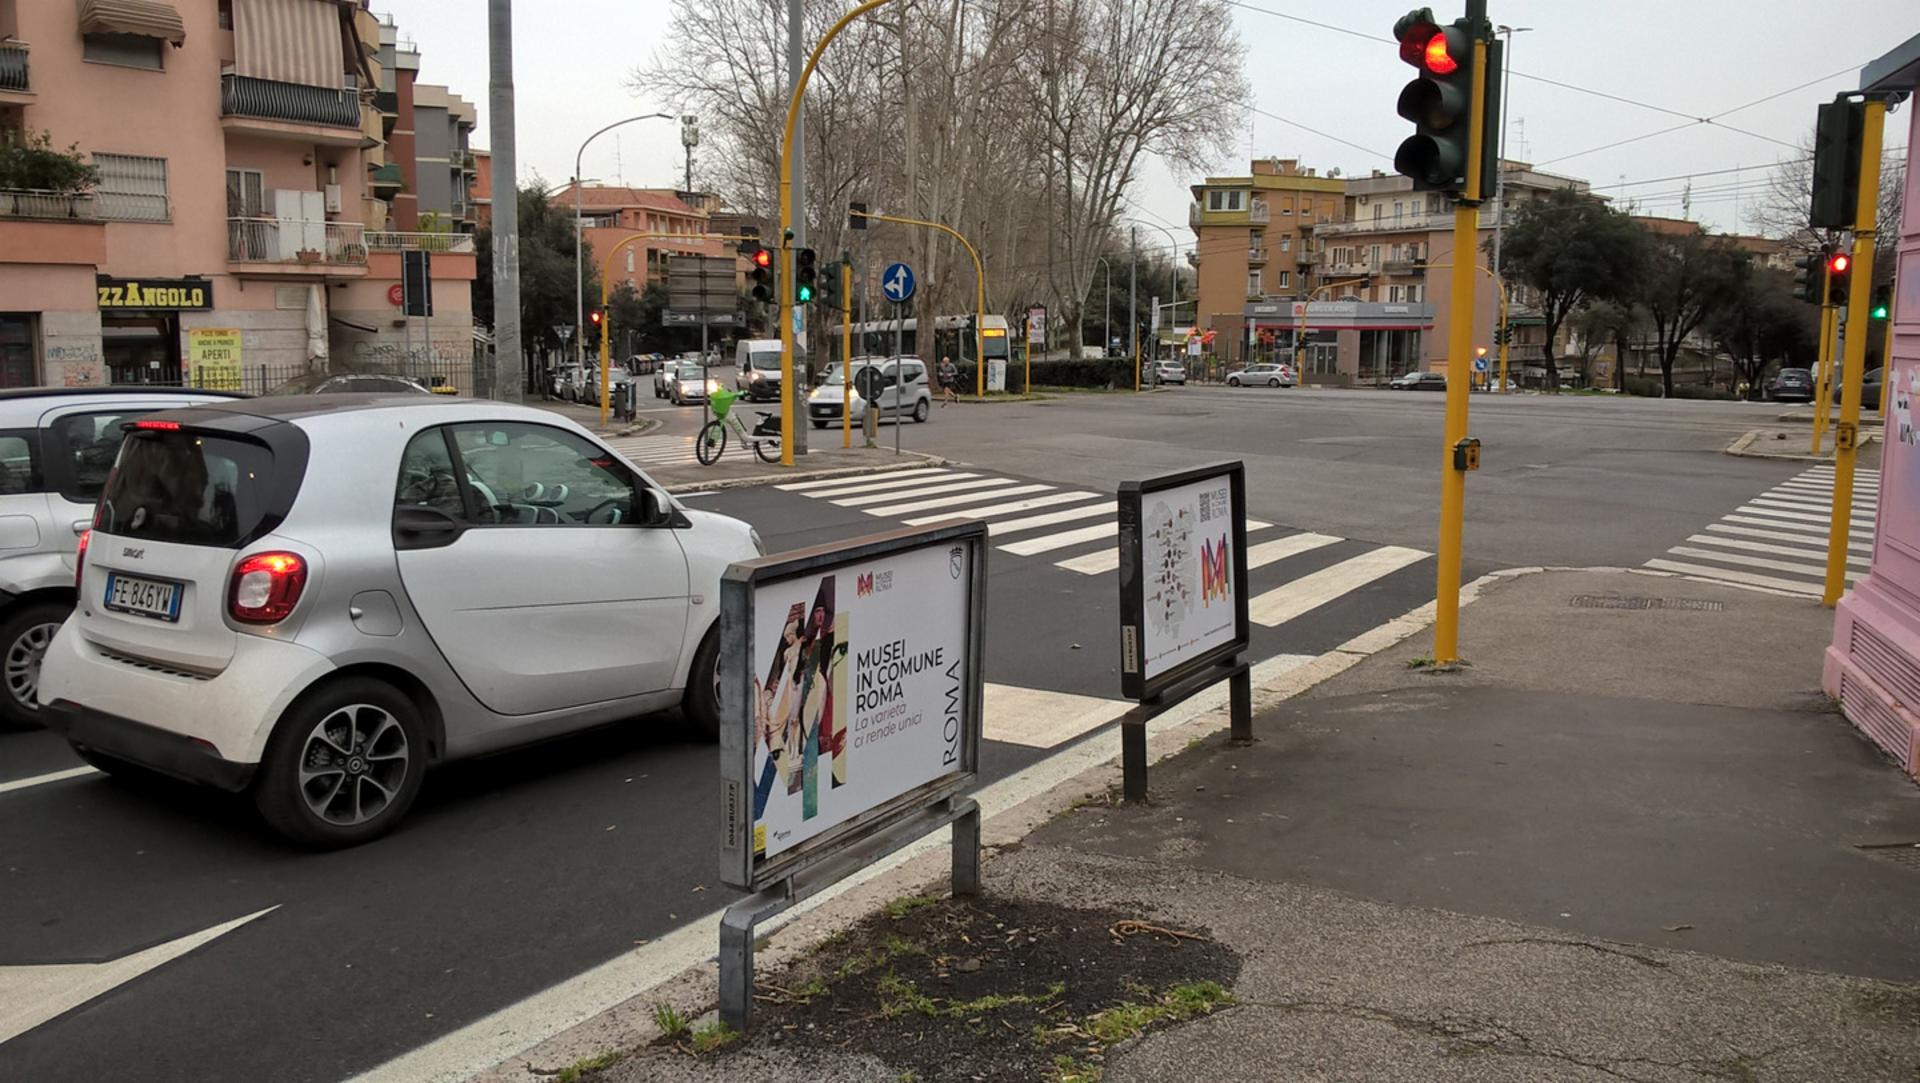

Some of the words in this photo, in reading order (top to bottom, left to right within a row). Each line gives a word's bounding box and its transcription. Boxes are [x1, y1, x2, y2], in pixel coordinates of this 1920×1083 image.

[202, 349, 231, 360] APERTI
[856, 639, 905, 673] MUSEI
[856, 669, 873, 694] IN
[877, 647, 944, 685] COMUNE
[856, 681, 904, 714] ROMA
[942, 658, 960, 766] ROMA
[855, 717, 868, 732] La
[865, 720, 896, 744] rende
[898, 711, 922, 731] unici
